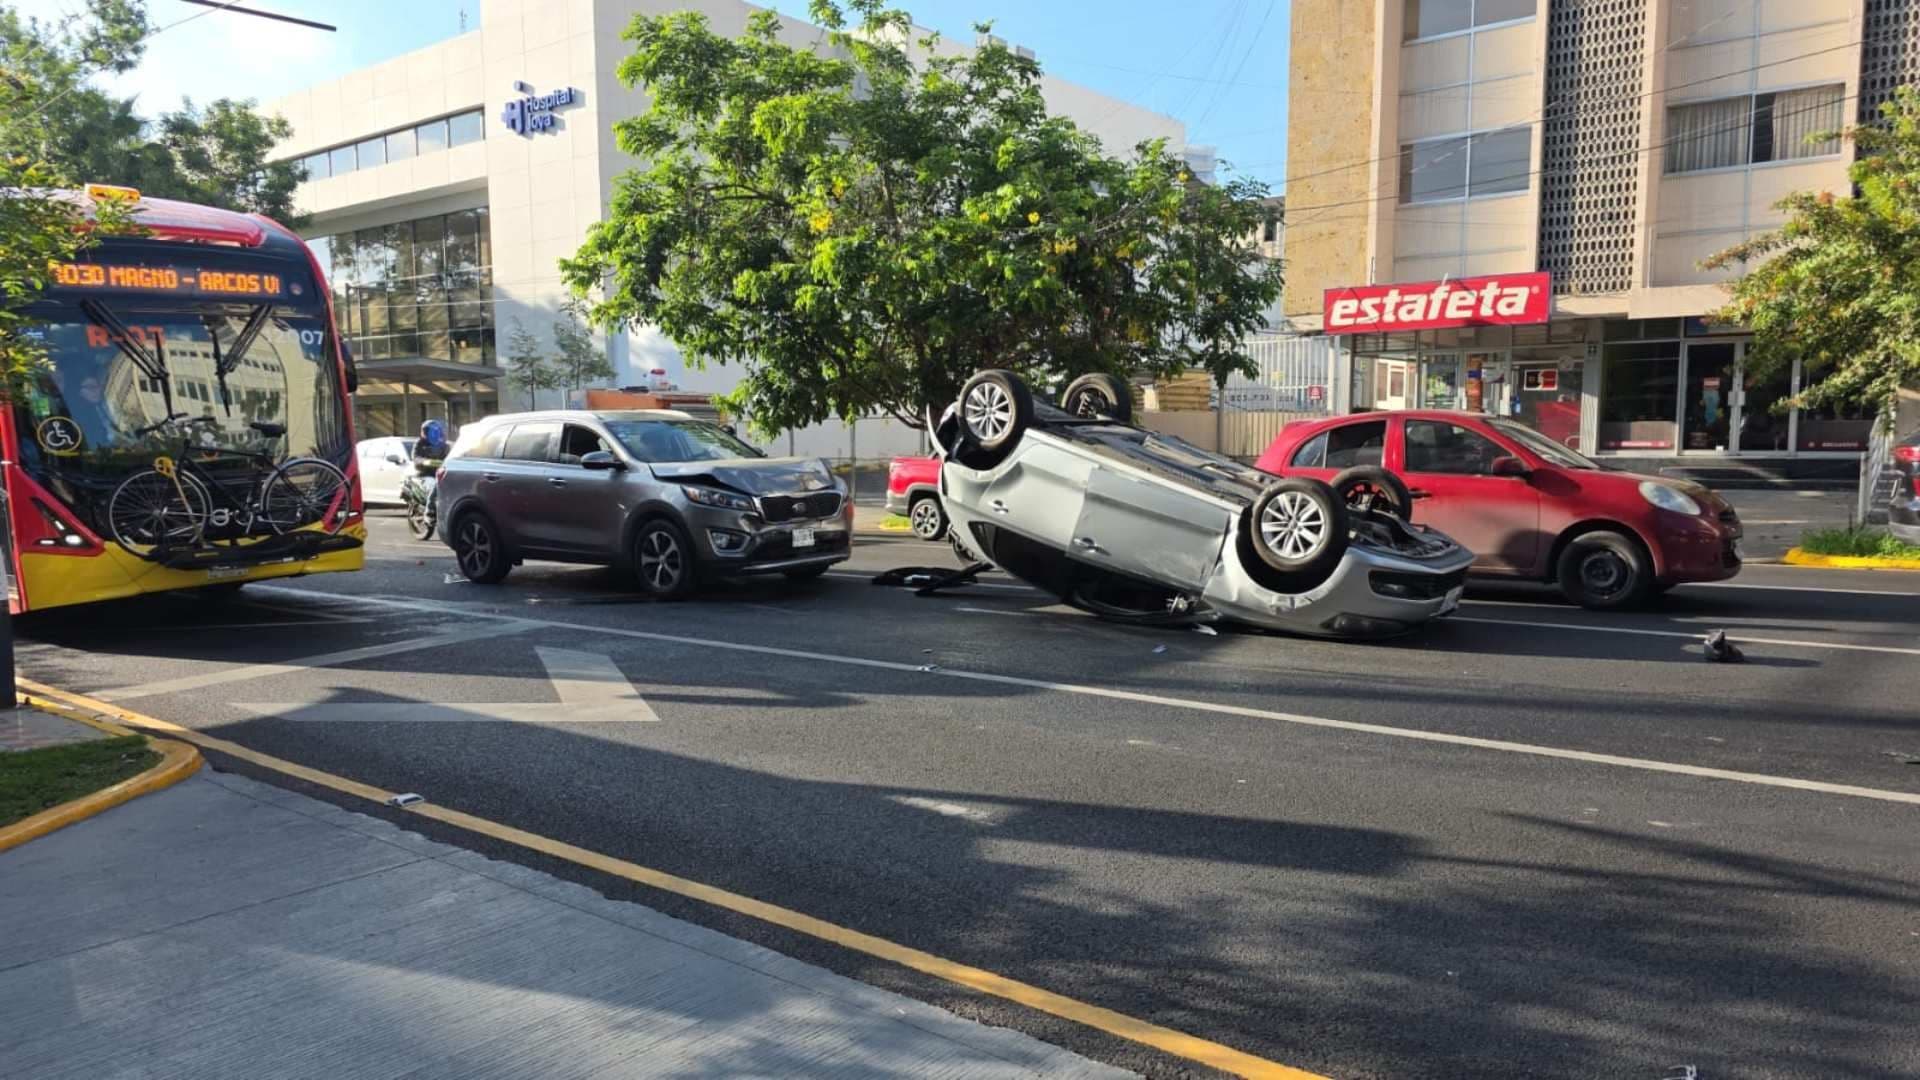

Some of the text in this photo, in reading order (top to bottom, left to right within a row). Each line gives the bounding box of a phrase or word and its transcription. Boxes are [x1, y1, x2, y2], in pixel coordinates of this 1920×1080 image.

[525, 87, 572, 114] Hospital
[109, 266, 178, 288] MAGNO
[199, 271, 260, 293] ARCOS
[1329, 281, 1530, 327] estafeta
